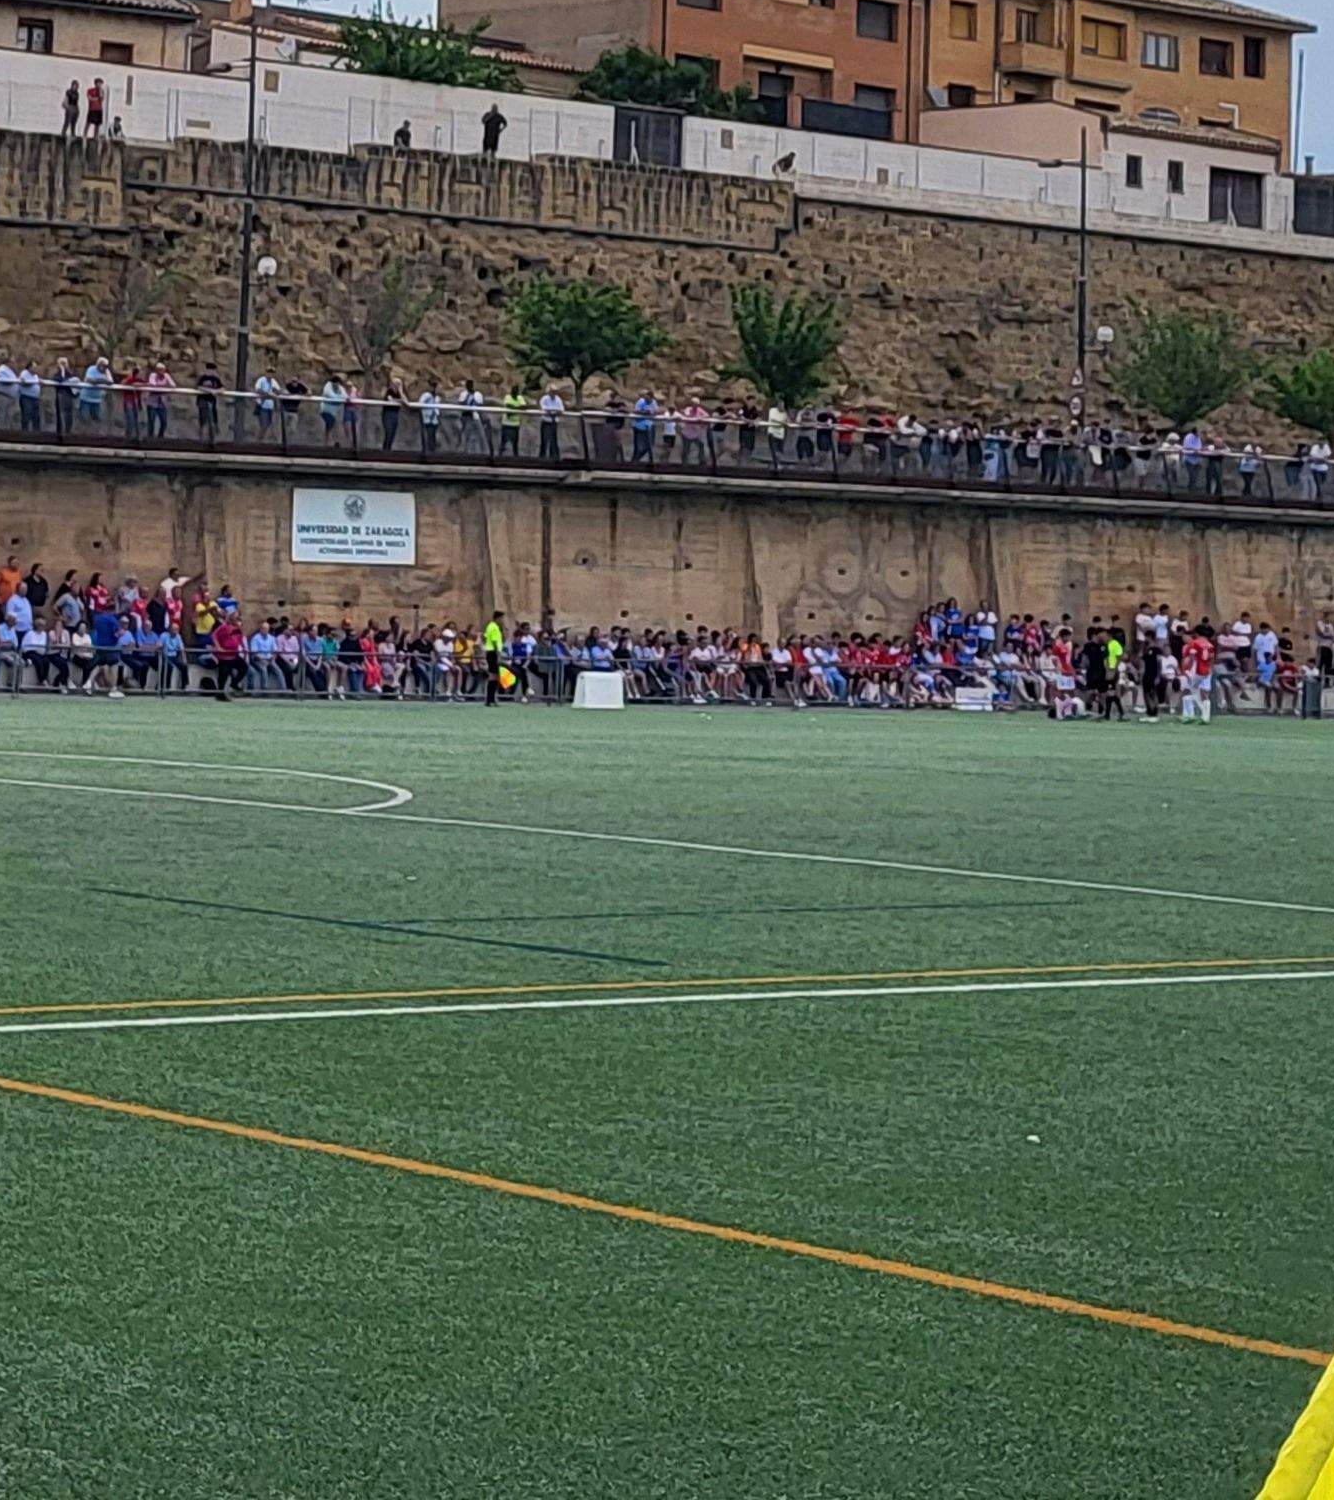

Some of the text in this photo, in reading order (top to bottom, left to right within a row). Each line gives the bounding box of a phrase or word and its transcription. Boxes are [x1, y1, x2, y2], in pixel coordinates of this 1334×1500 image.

[297, 525, 410, 537] UNIVERSIDAD DE ZARAGOZA
